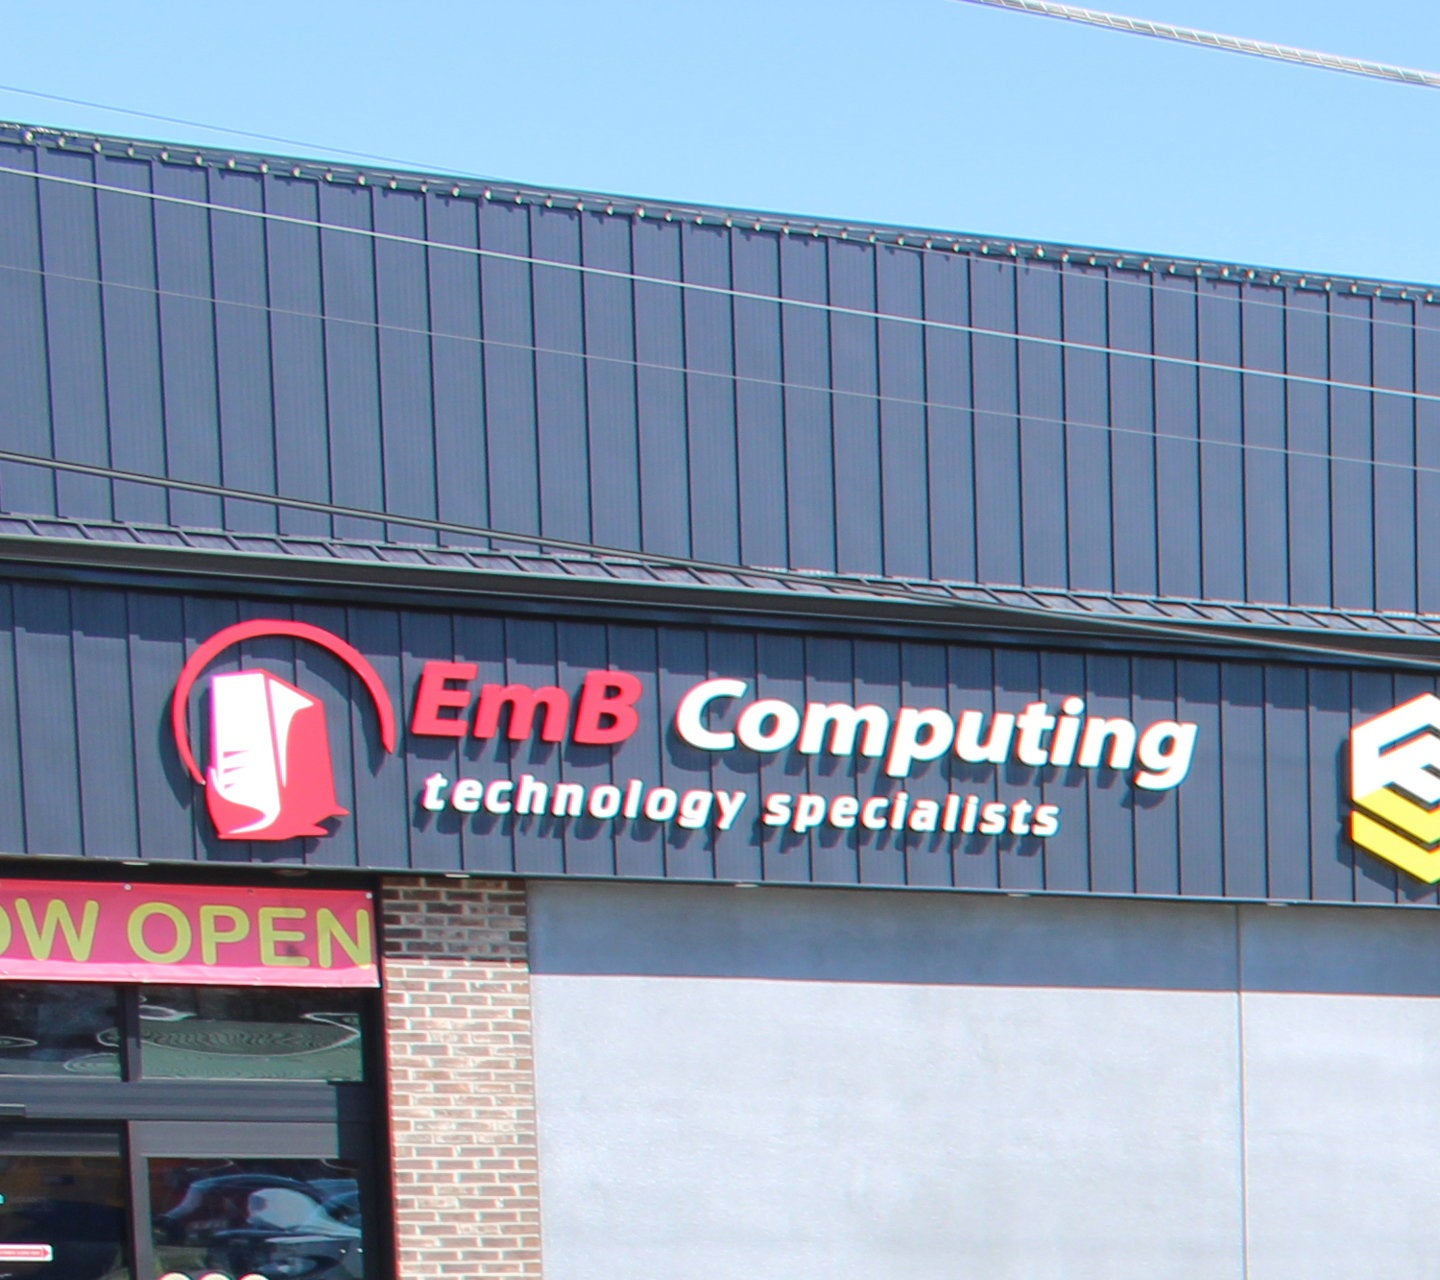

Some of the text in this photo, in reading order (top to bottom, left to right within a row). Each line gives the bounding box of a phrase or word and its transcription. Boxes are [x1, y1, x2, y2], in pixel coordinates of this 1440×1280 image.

[411, 661, 1198, 791] EmB Computing
[421, 772, 1061, 838] technology specialists
[127, 902, 374, 970] OPEN
